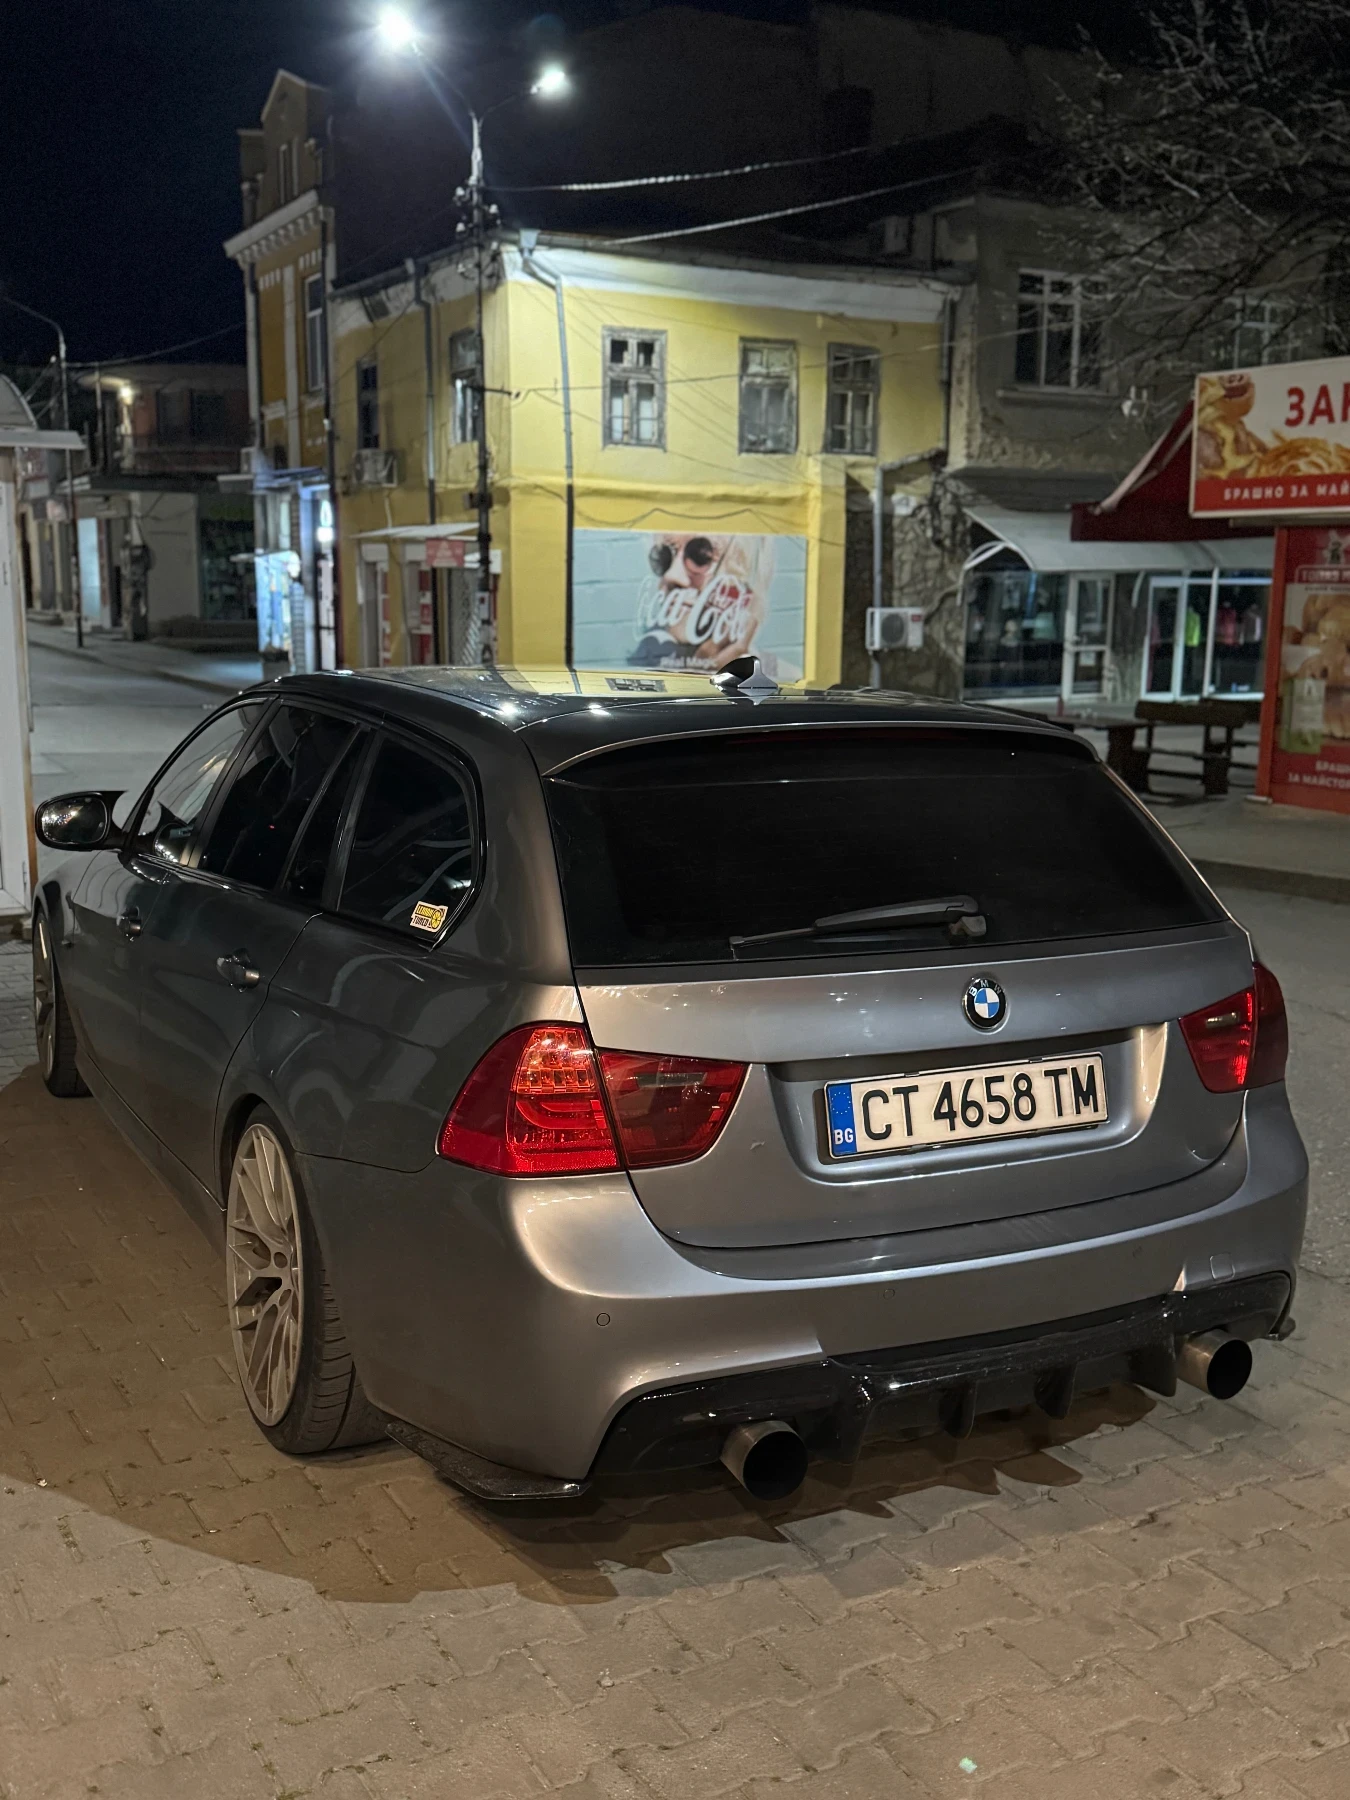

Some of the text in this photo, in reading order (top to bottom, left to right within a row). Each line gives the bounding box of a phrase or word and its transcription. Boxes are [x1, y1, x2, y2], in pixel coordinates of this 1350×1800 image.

[1224, 485, 1284, 501] БРАШНО
[1290, 484, 1308, 498] ЗА
[968, 979, 1002, 997] BMW
[833, 1064, 1099, 1145] BG CT 4658 TM
